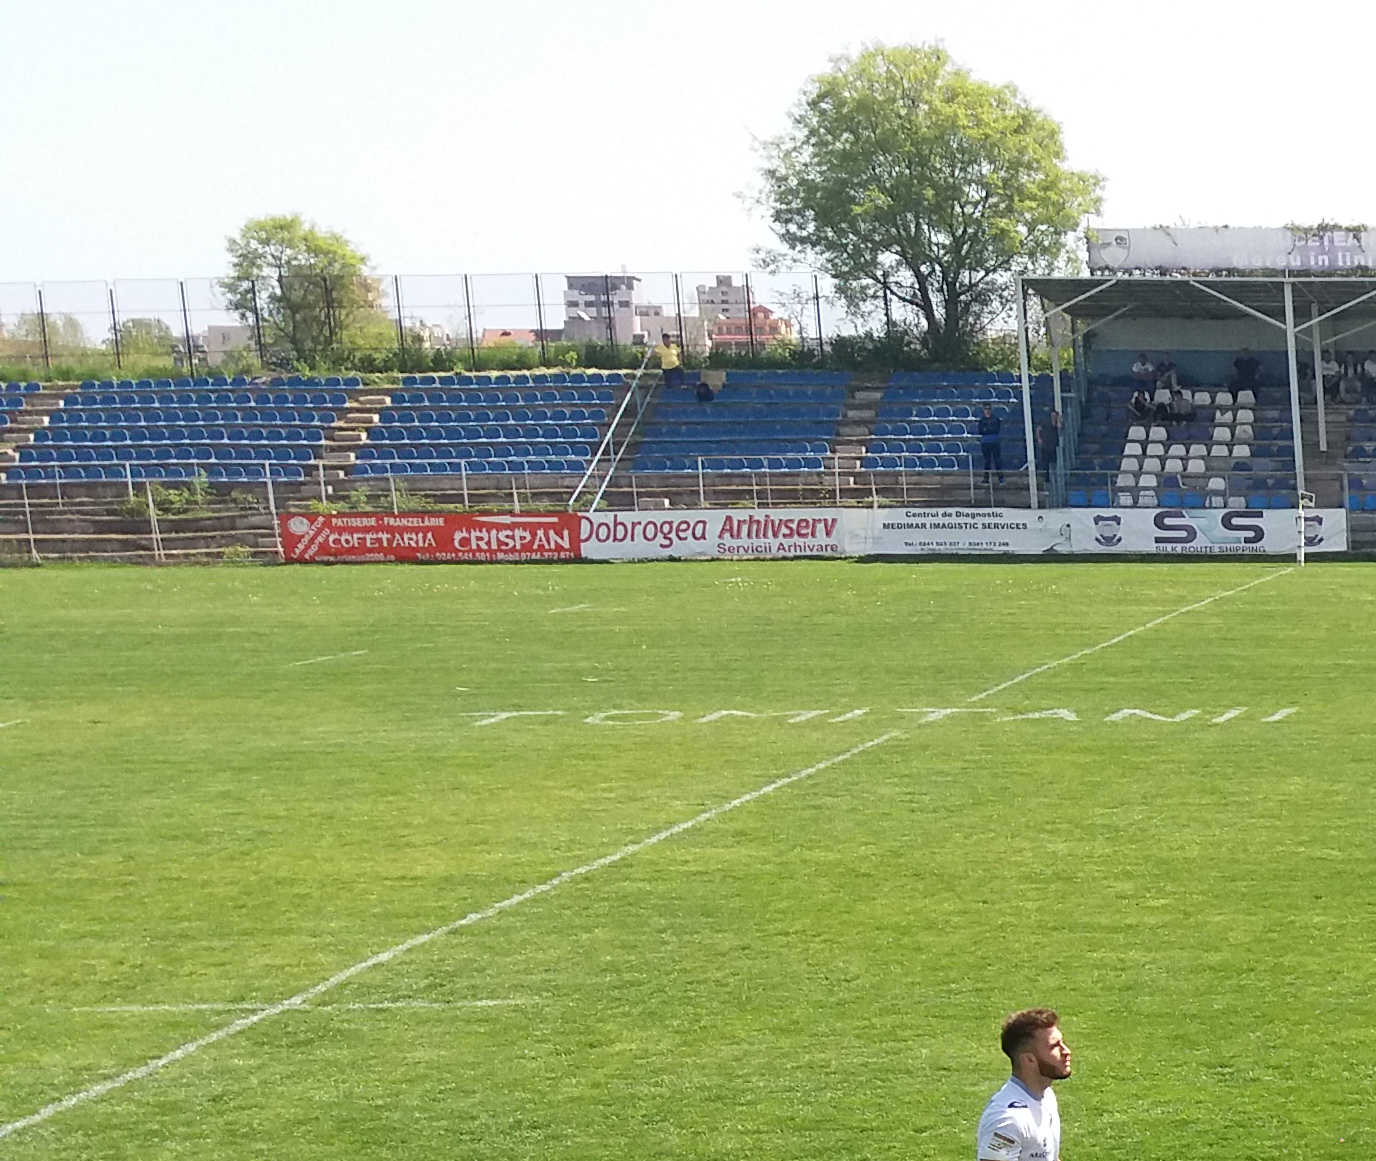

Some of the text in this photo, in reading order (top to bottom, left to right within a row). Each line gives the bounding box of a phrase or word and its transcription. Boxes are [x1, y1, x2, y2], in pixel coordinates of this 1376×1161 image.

[905, 510, 1004, 520] Centrul de Diagnostic
[580, 514, 838, 549] Dobrogea Arhivserv
[882, 522, 1028, 530] MEDIMAR IMAGISTIC SERVICES
[453, 527, 570, 550] CRISPAN
[716, 542, 839, 554] Servicii Arhivare
[1155, 545, 1266, 554] SILK ROUTE SHIPPING
